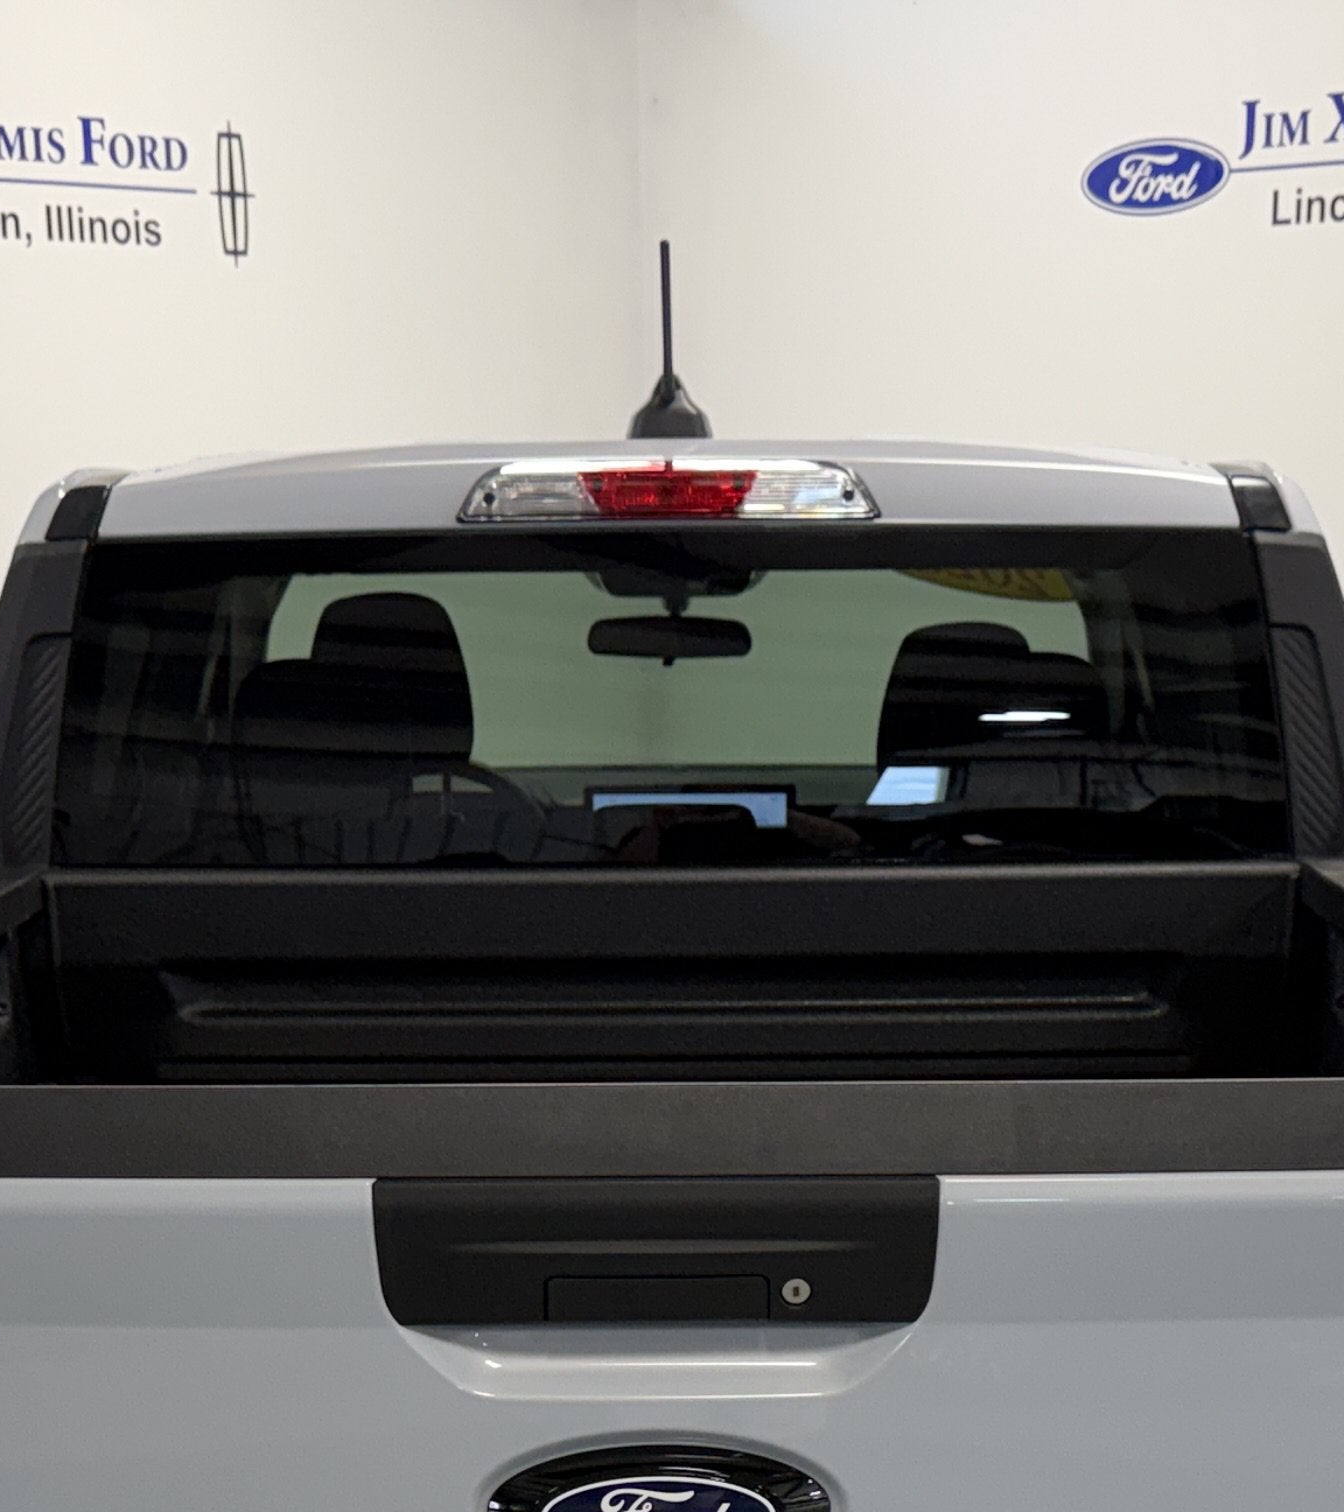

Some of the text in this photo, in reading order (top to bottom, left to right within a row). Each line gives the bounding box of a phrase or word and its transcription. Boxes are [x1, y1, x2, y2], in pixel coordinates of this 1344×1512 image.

[77, 116, 188, 172] FORD
[1239, 99, 1311, 159] JIM
[1108, 151, 1199, 203] Ford
[46, 204, 162, 247] Illinois
